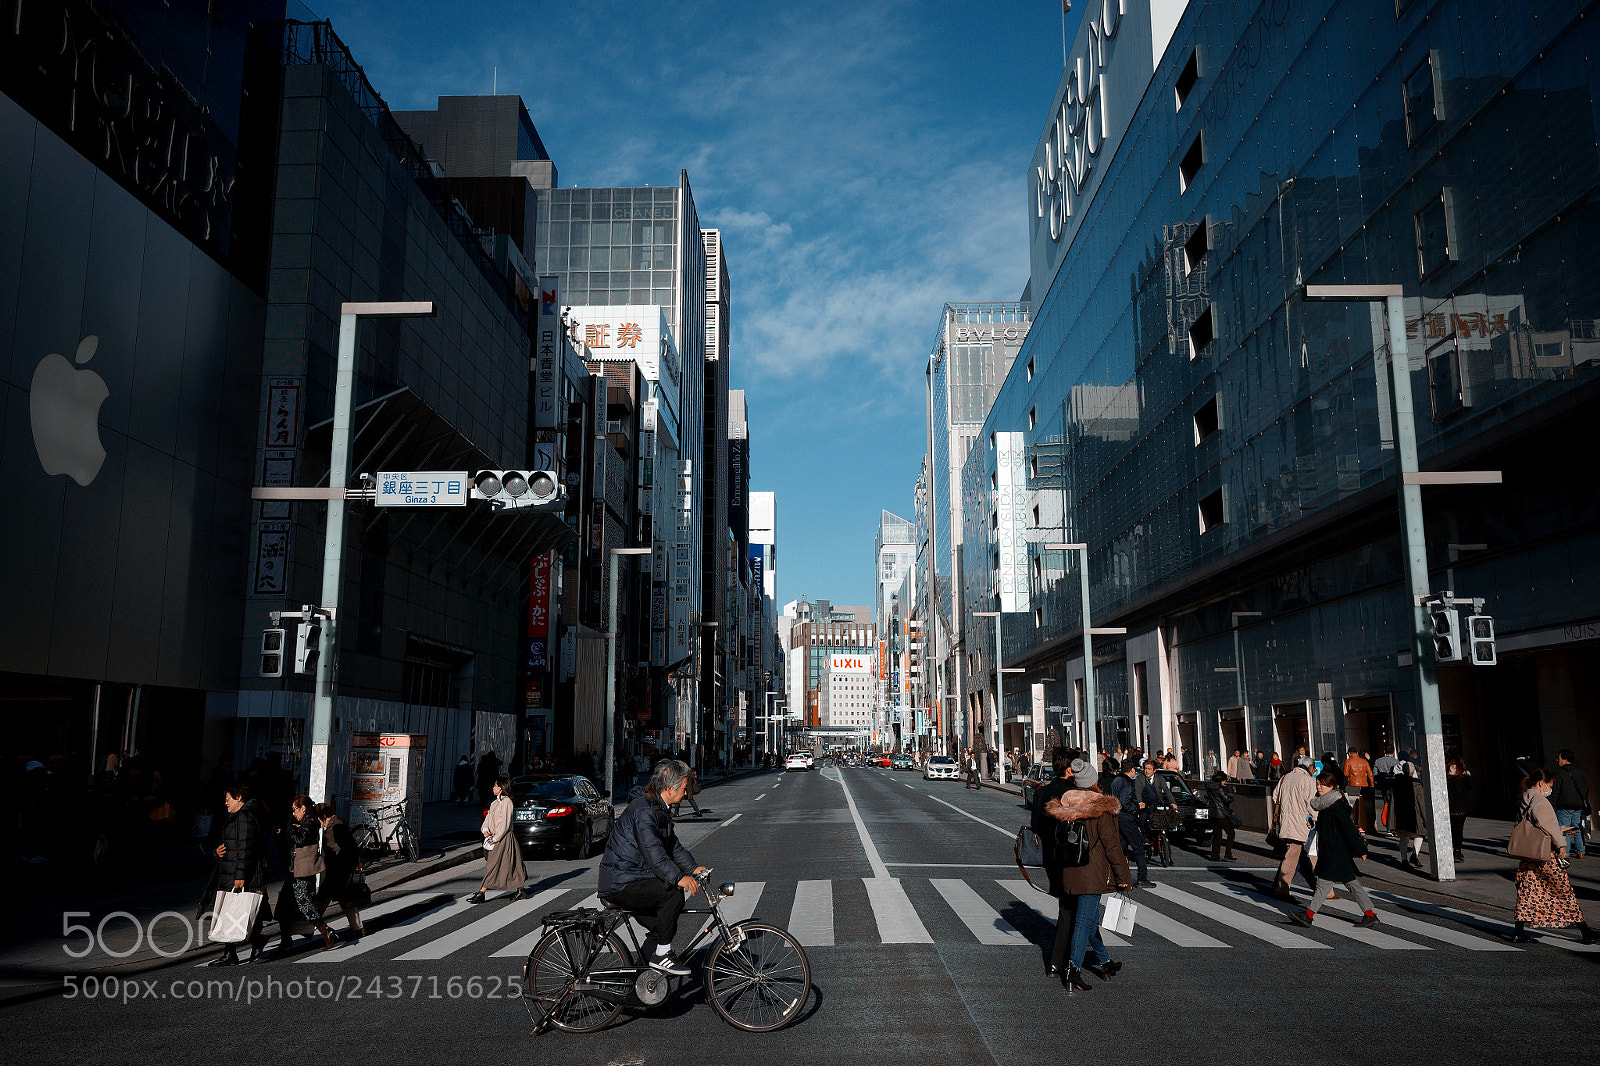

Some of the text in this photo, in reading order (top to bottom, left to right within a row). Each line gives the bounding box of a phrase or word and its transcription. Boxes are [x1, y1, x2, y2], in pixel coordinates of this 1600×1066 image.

[614, 208, 672, 219] CHANEL
[573, 322, 642, 348] 証券
[539, 330, 554, 412] 日本香堂ビル
[382, 481, 460, 495] 銀座三丁目
[405, 495, 436, 503] Ginza 3
[833, 659, 864, 669] LIXIL
[366, 737, 395, 747] 宝くじ
